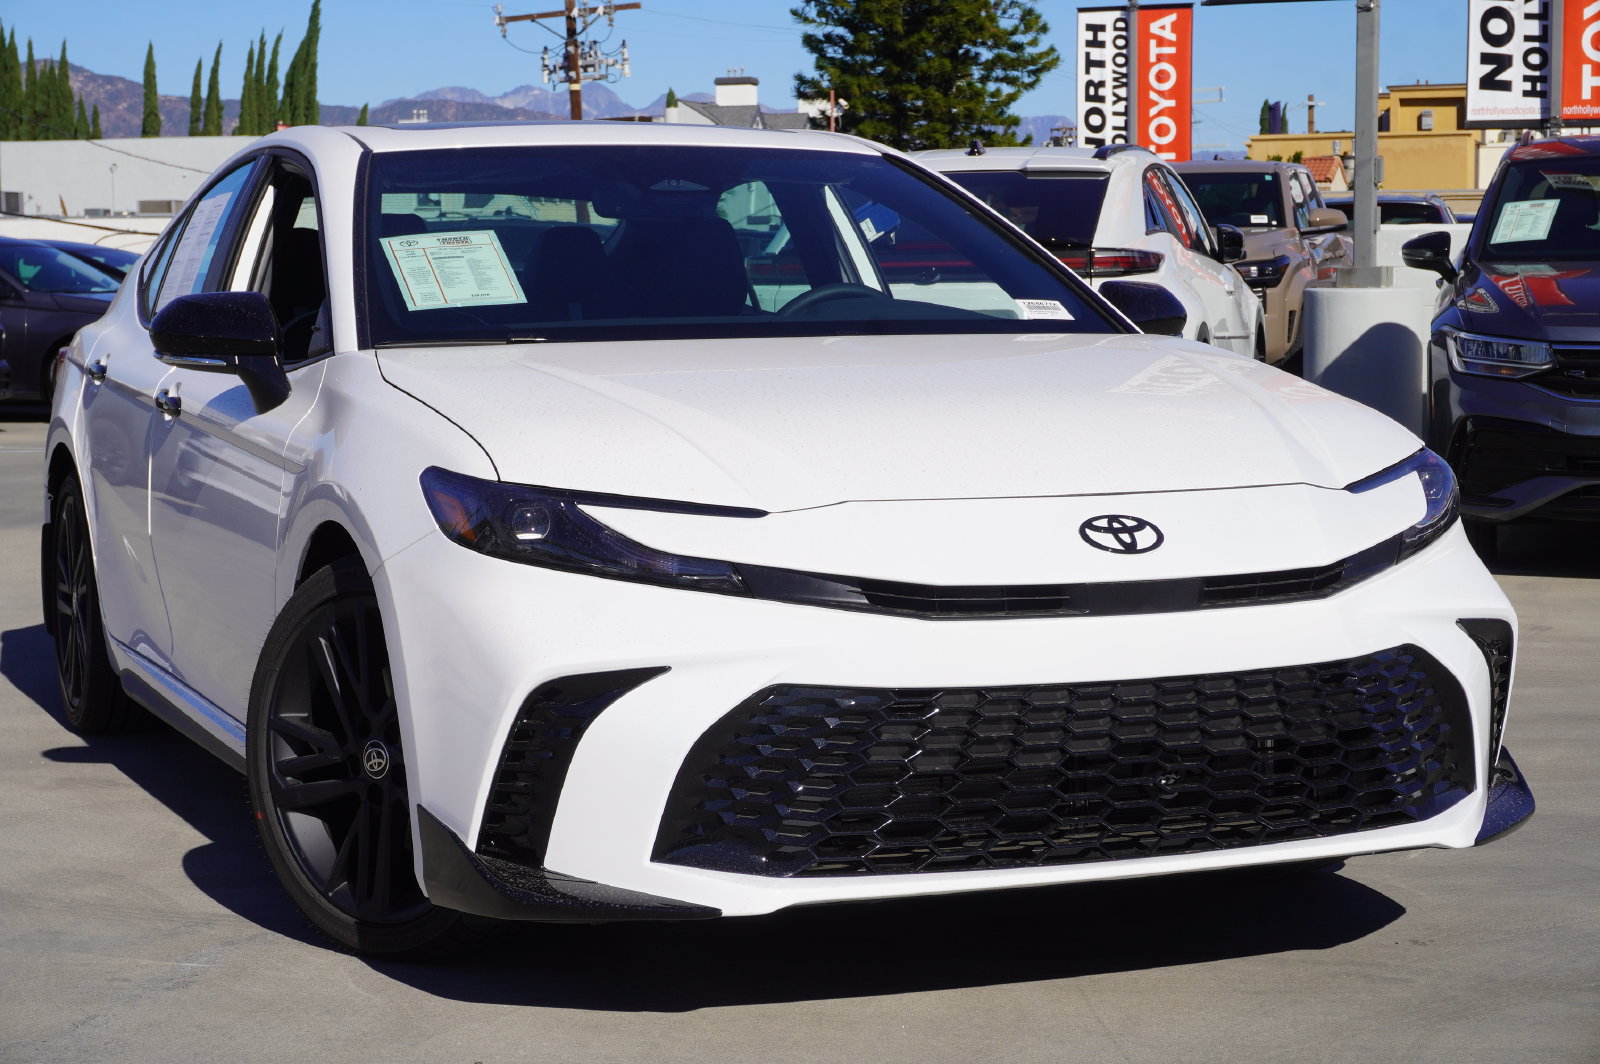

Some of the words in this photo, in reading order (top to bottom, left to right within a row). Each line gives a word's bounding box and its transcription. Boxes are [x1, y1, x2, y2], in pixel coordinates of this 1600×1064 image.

[1111, 17, 1129, 145] OLLYWOOD
[1149, 13, 1177, 160] TOYOTA
[1479, 0, 1515, 92] NO
[1522, 0, 1549, 98] HOLL
